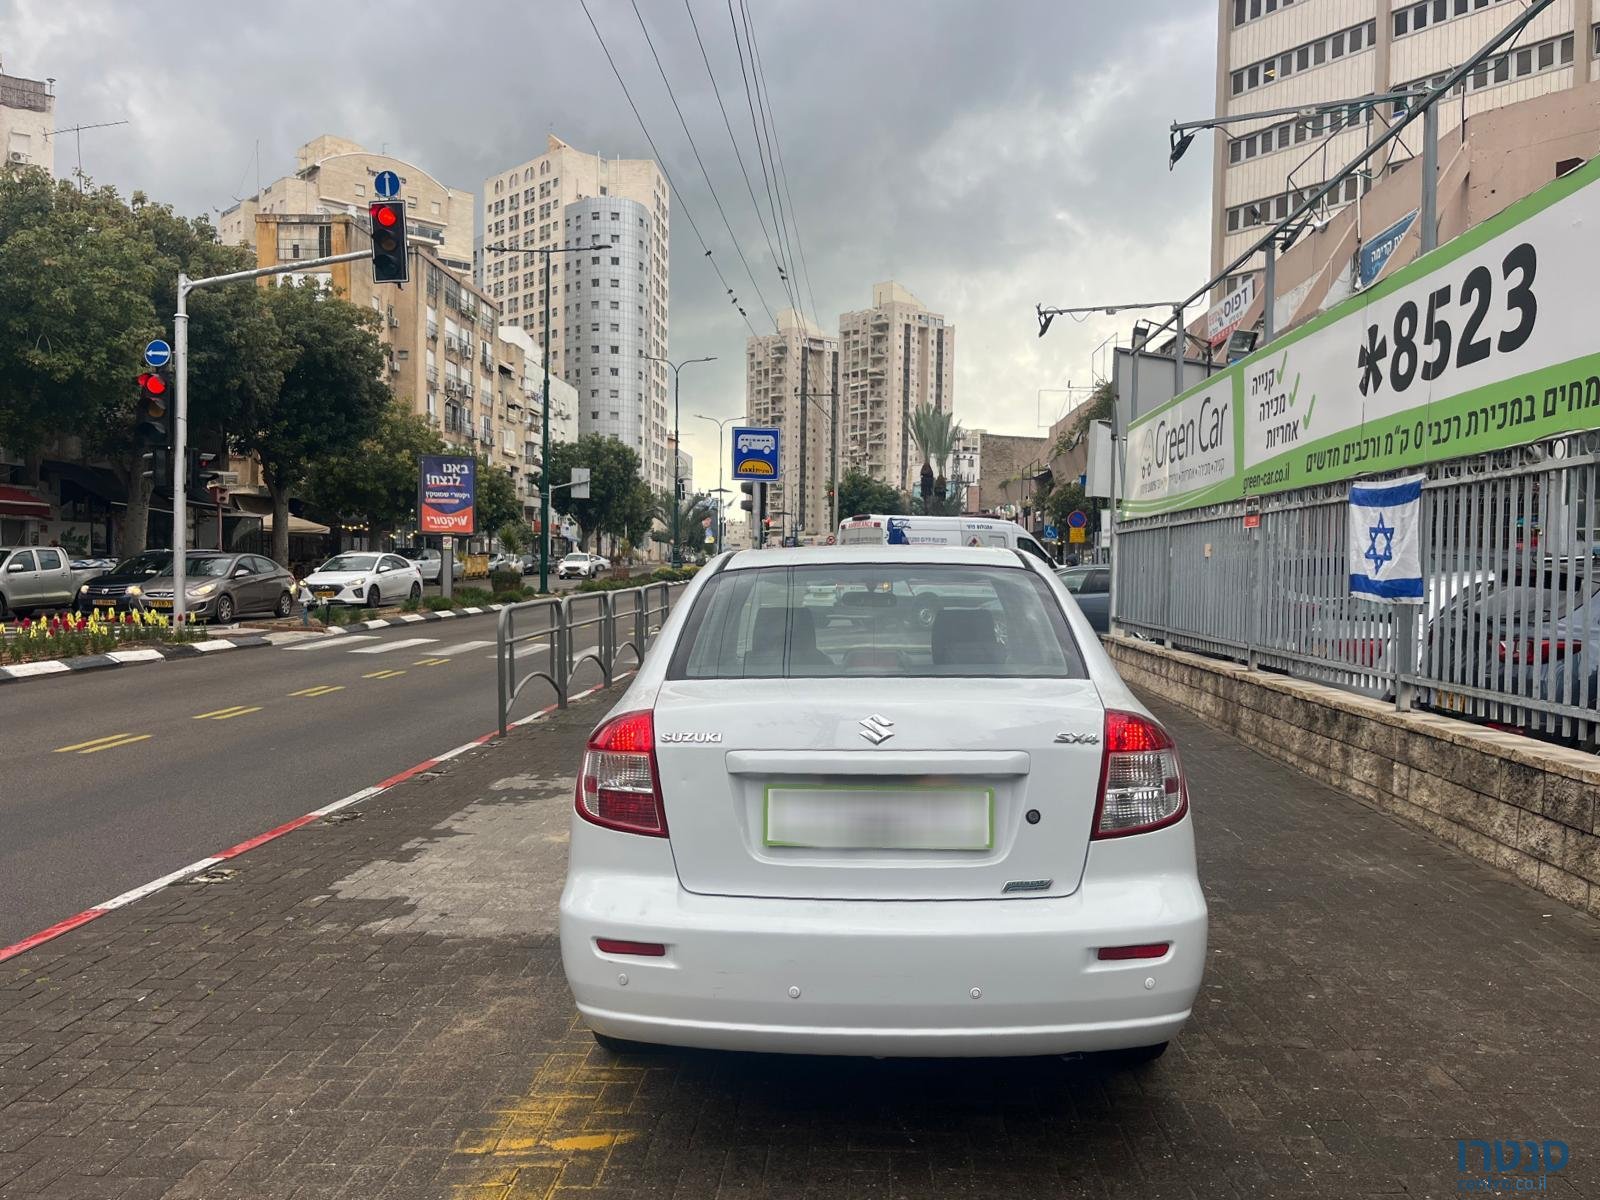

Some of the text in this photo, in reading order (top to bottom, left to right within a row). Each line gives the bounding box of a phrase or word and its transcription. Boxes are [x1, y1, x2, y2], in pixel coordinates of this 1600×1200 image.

[1224, 287, 1248, 317] דפוס
[1252, 368, 1275, 396] קנייה
[1259, 393, 1286, 422] מכירה
[1465, 395, 1535, 437] במכירת
[1156, 397, 1228, 468] Green Car
[1266, 419, 1300, 449] אחריות
[1428, 415, 1462, 445] רכבי
[1306, 447, 1340, 473] חדשים
[1343, 435, 1380, 464] ורכבים
[426, 474, 460, 486] לנצח!
[443, 464, 469, 474] באנו
[1243, 462, 1290, 494] green-car.co.il
[661, 732, 723, 743] SUZUKI
[1054, 732, 1099, 745] SX4
